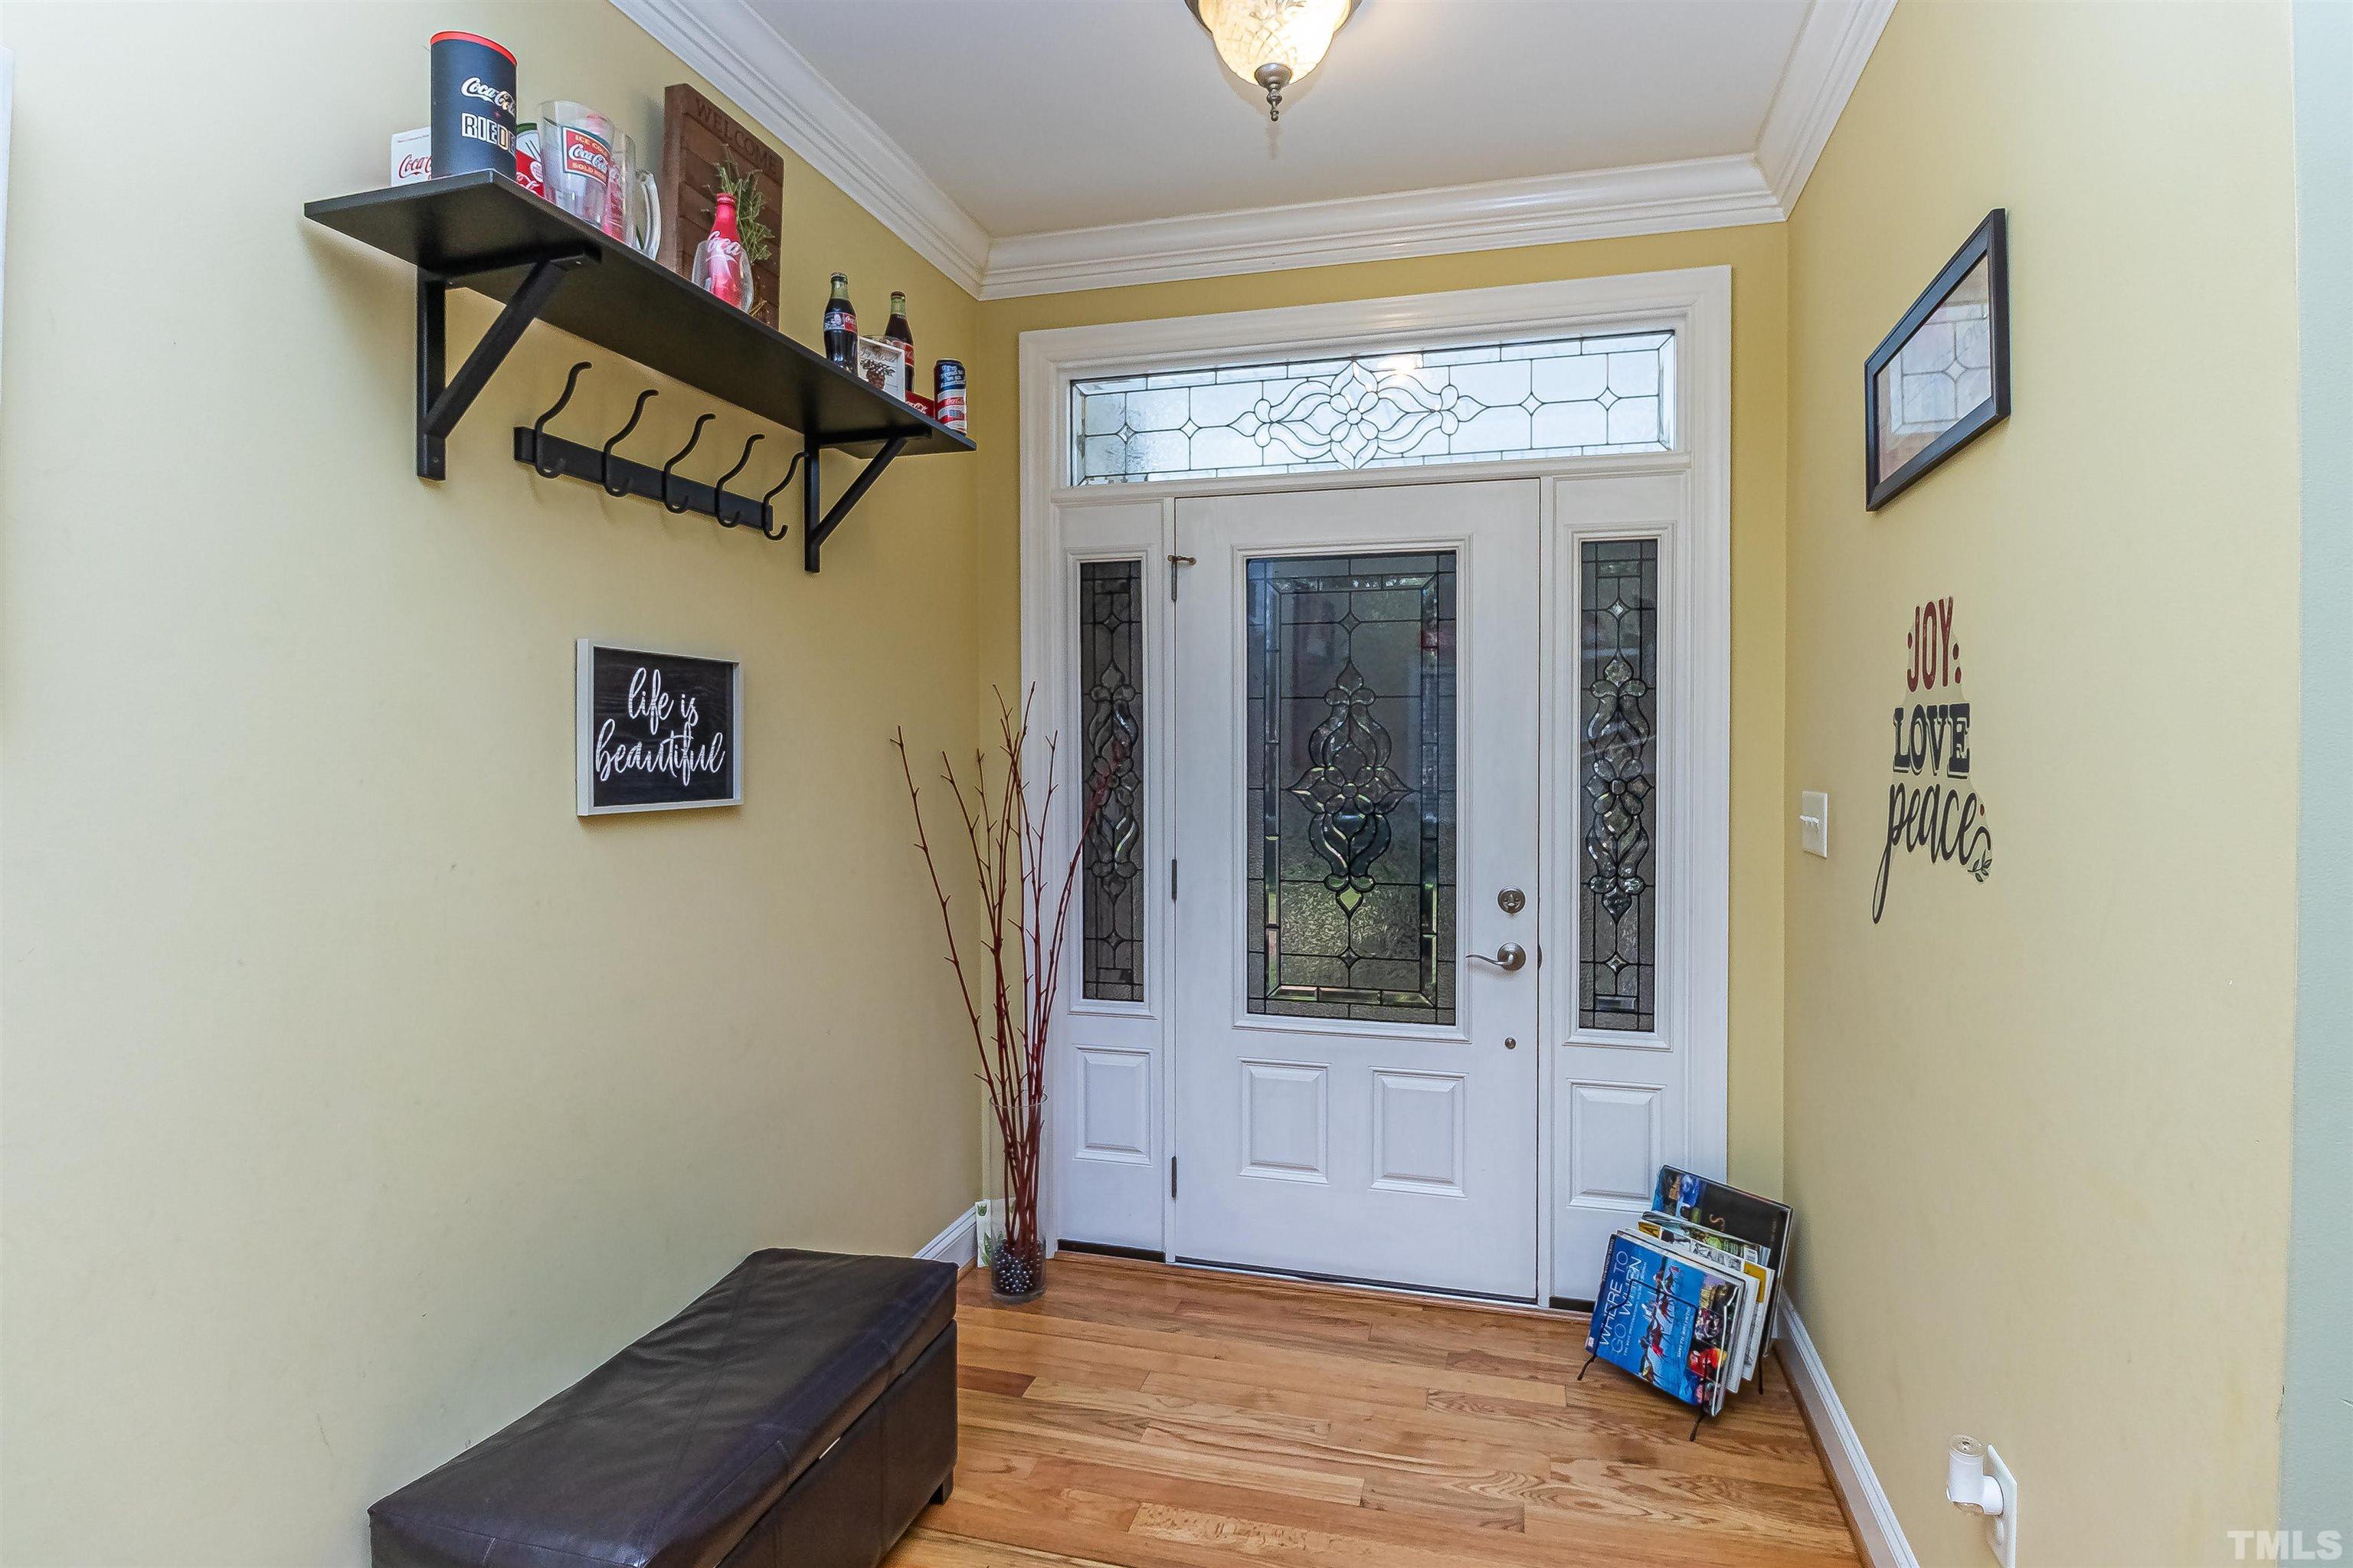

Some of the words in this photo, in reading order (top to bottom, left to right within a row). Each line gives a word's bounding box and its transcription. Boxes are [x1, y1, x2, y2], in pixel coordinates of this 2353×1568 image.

[575, 134, 590, 146] ICE
[695, 97, 779, 175] WELCOME
[628, 666, 675, 735] life
[680, 693, 699, 727] is
[595, 718, 726, 787] beautiful
[1893, 702, 1971, 780] LOVE
[1871, 782, 1991, 925] peace
[1599, 1279, 1623, 1346] WHERE
[1613, 1251, 1628, 1273] TO
[1618, 1256, 1642, 1316] WHEN
[1612, 1323, 1627, 1354] GO
